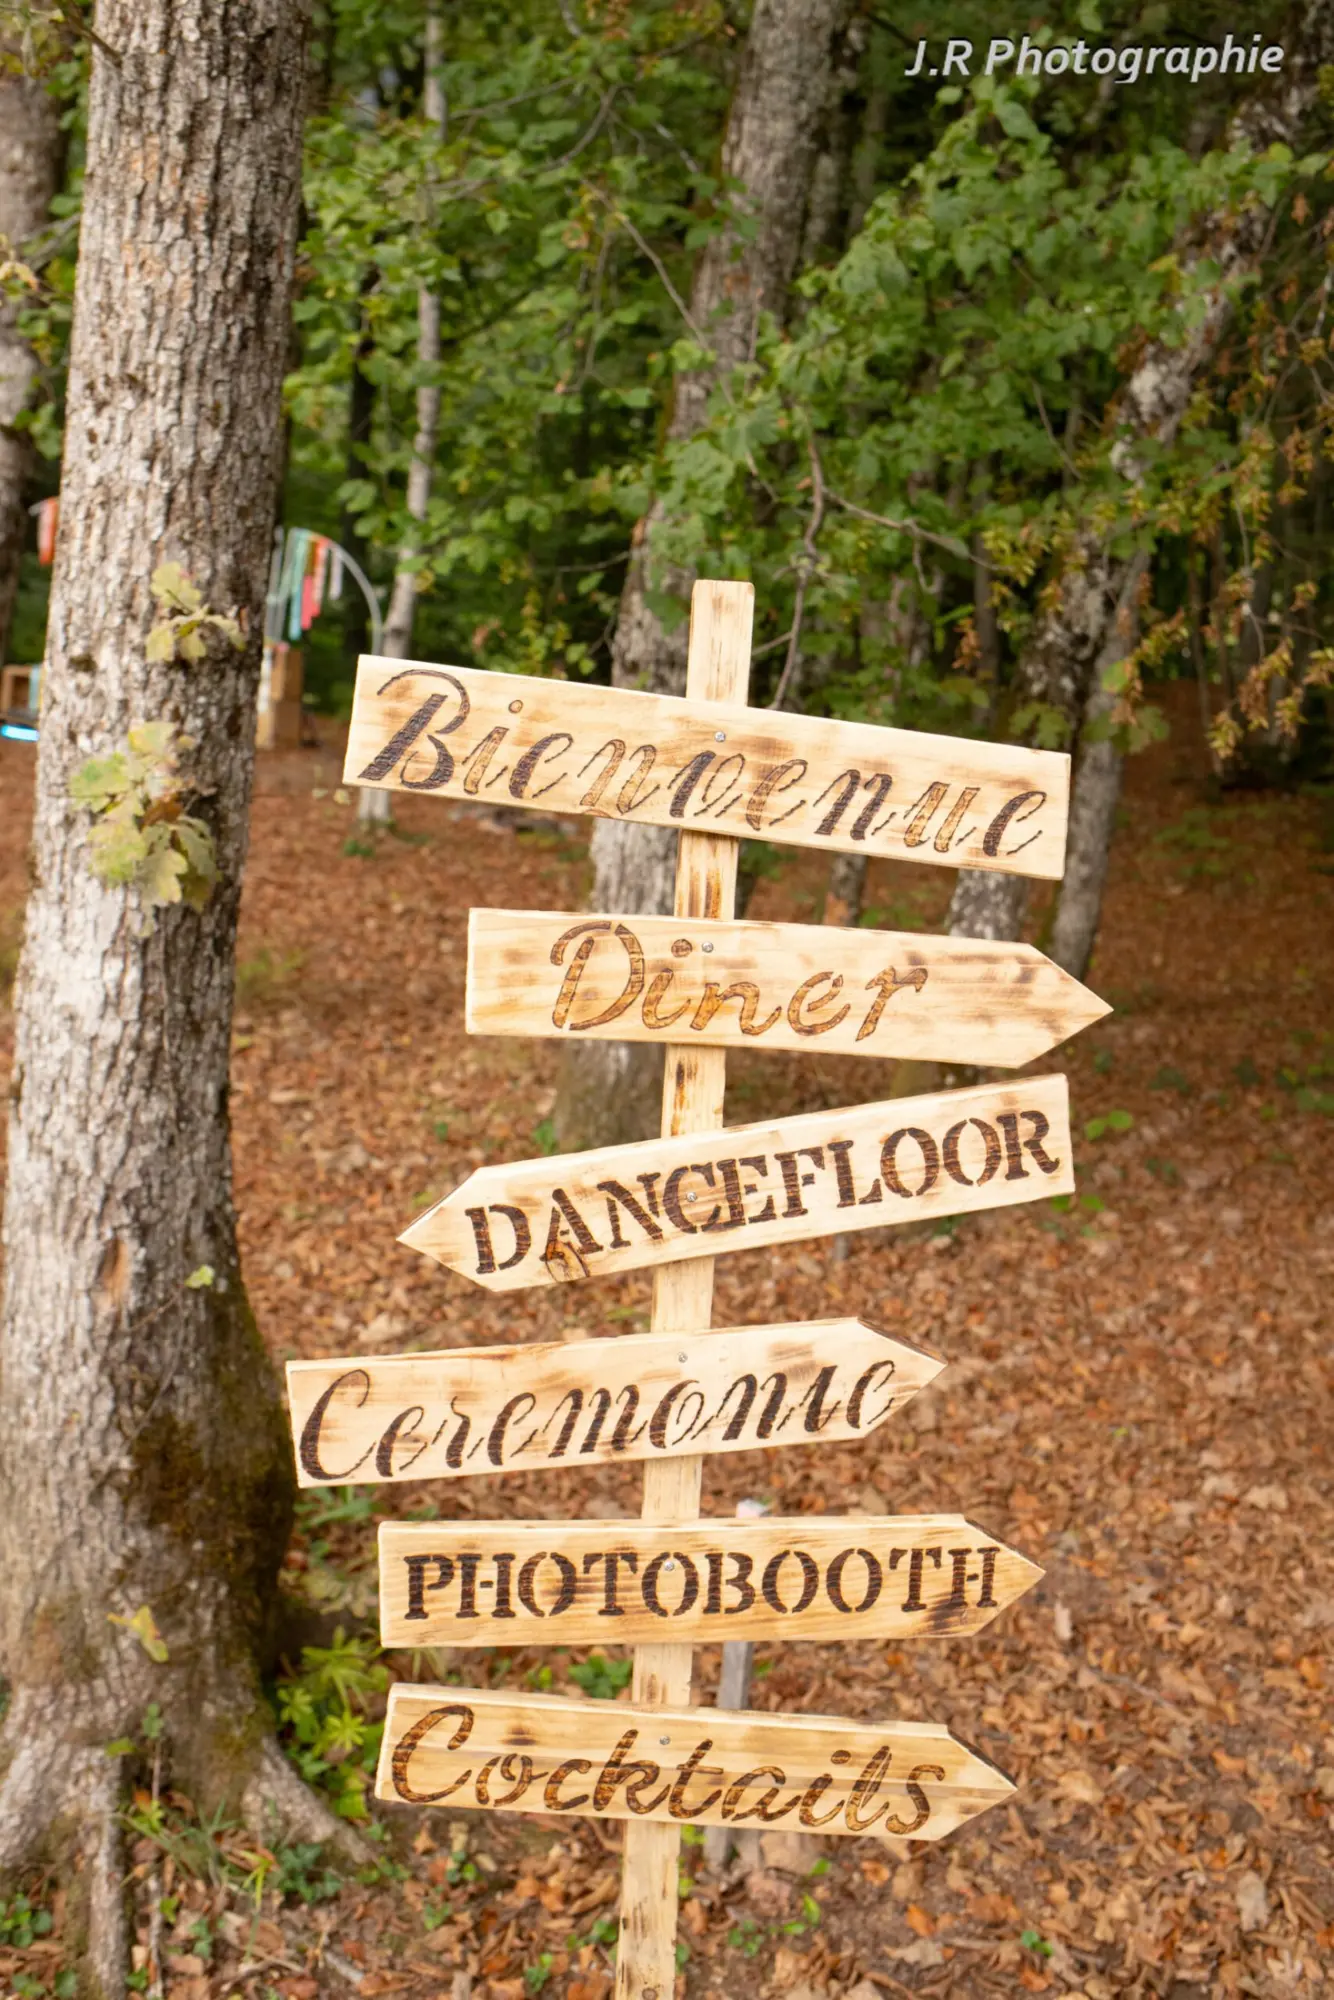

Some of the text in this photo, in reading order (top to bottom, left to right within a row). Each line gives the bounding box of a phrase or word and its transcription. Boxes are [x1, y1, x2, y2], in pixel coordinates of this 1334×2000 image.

[358, 668, 1049, 858] Bienvenue
[550, 920, 930, 1043] Diner
[463, 1109, 1061, 1276] DANCEFLOOR
[300, 1359, 896, 1481] Ceremonie
[404, 1546, 1001, 1620] PHOTOBOOTH
[391, 1704, 946, 1835] Cocktails
